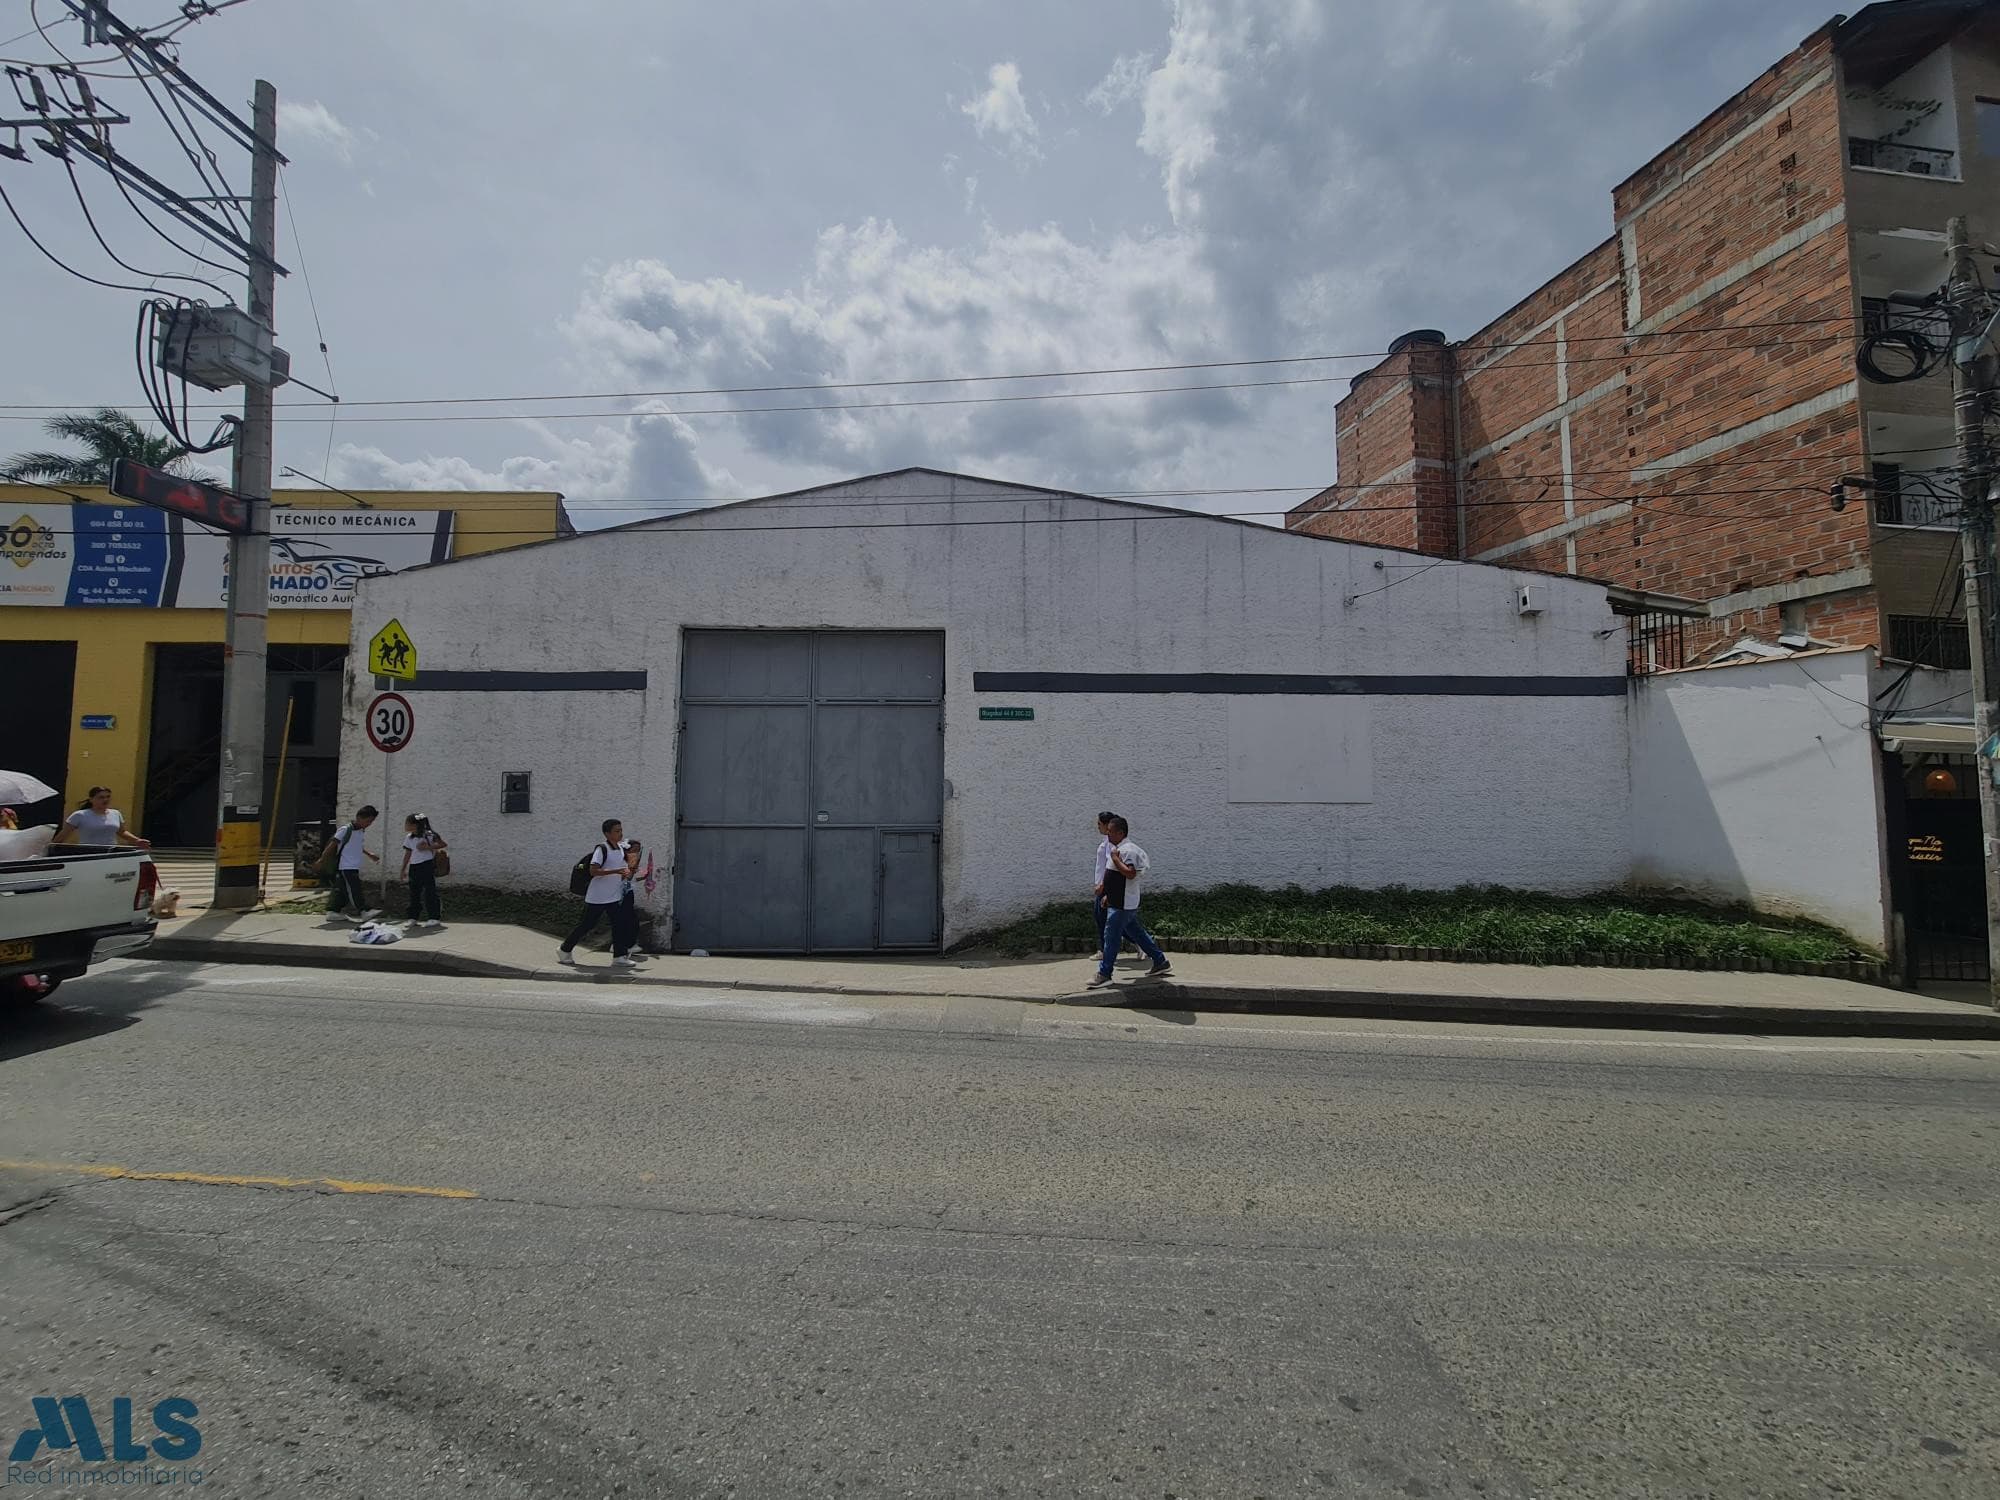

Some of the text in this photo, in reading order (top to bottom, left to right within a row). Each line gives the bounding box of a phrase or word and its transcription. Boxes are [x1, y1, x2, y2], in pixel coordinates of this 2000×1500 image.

[276, 513, 417, 527] TÉCNICO MECÁNICA
[267, 592, 328, 604] iagnóstico
[376, 708, 405, 736] 30
